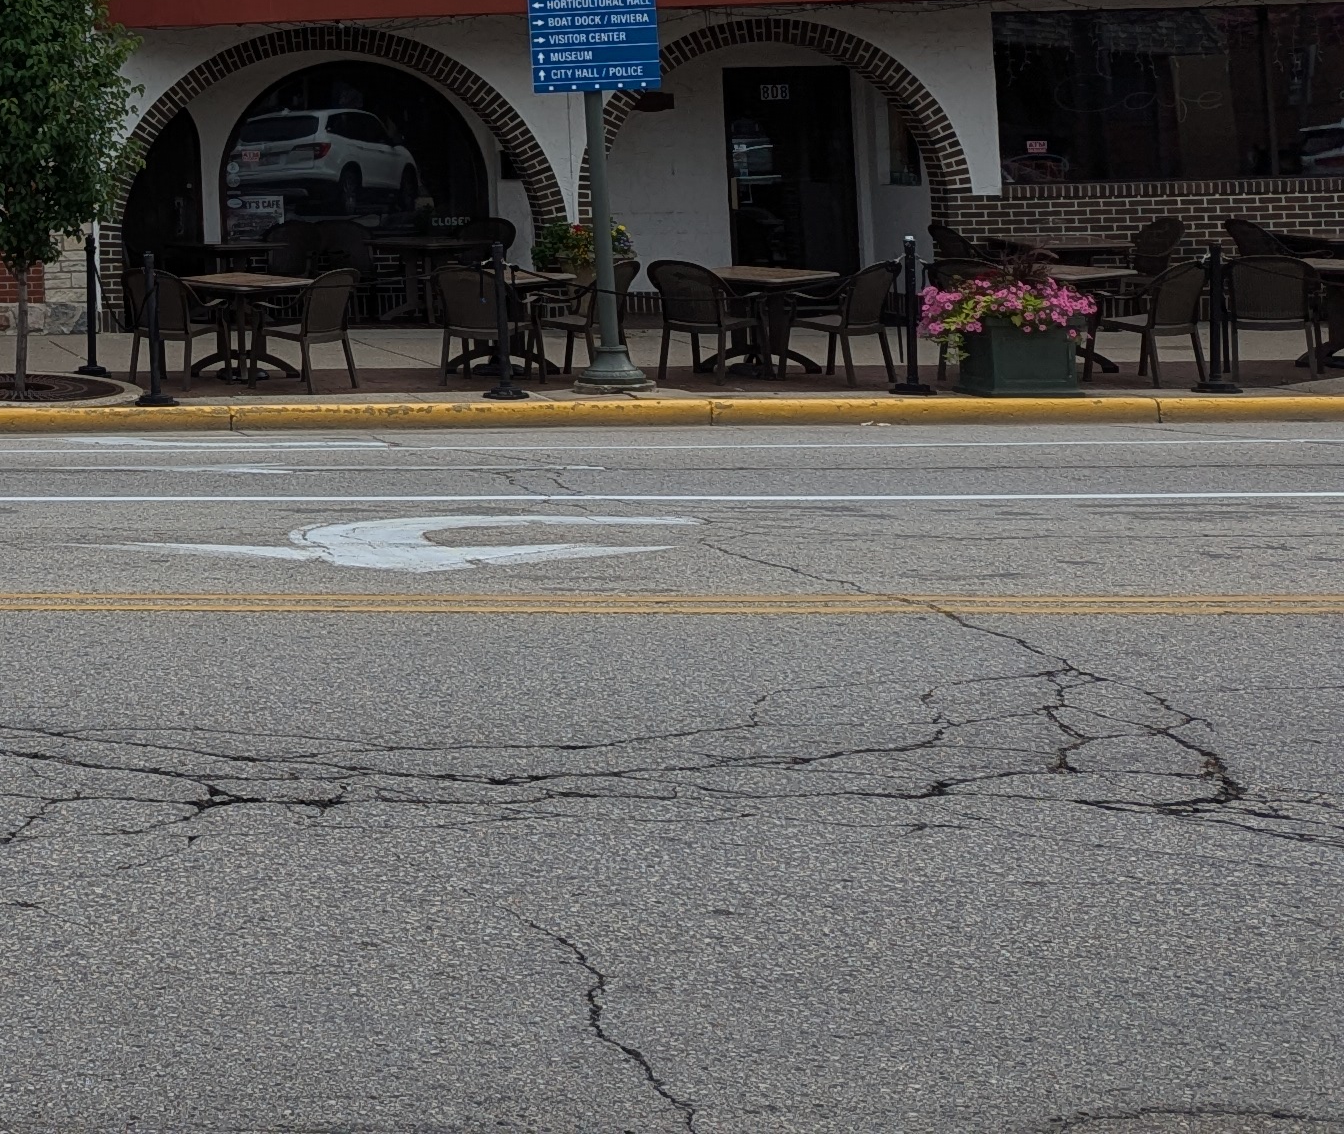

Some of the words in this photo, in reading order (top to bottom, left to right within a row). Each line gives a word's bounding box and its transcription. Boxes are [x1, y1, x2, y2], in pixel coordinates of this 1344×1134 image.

[548, 16, 573, 27] BOAT
[574, 15, 602, 26] DOCK
[610, 13, 650, 24] RIVIERA
[548, 33, 587, 45] VISITOR
[588, 31, 627, 43] CENTER
[550, 50, 593, 62] MUSEUM
[550, 69, 573, 80] CITY
[574, 67, 600, 78] HALL
[608, 65, 644, 77] POLICE
[762, 85, 789, 99] 808
[261, 199, 282, 209] CAFE
